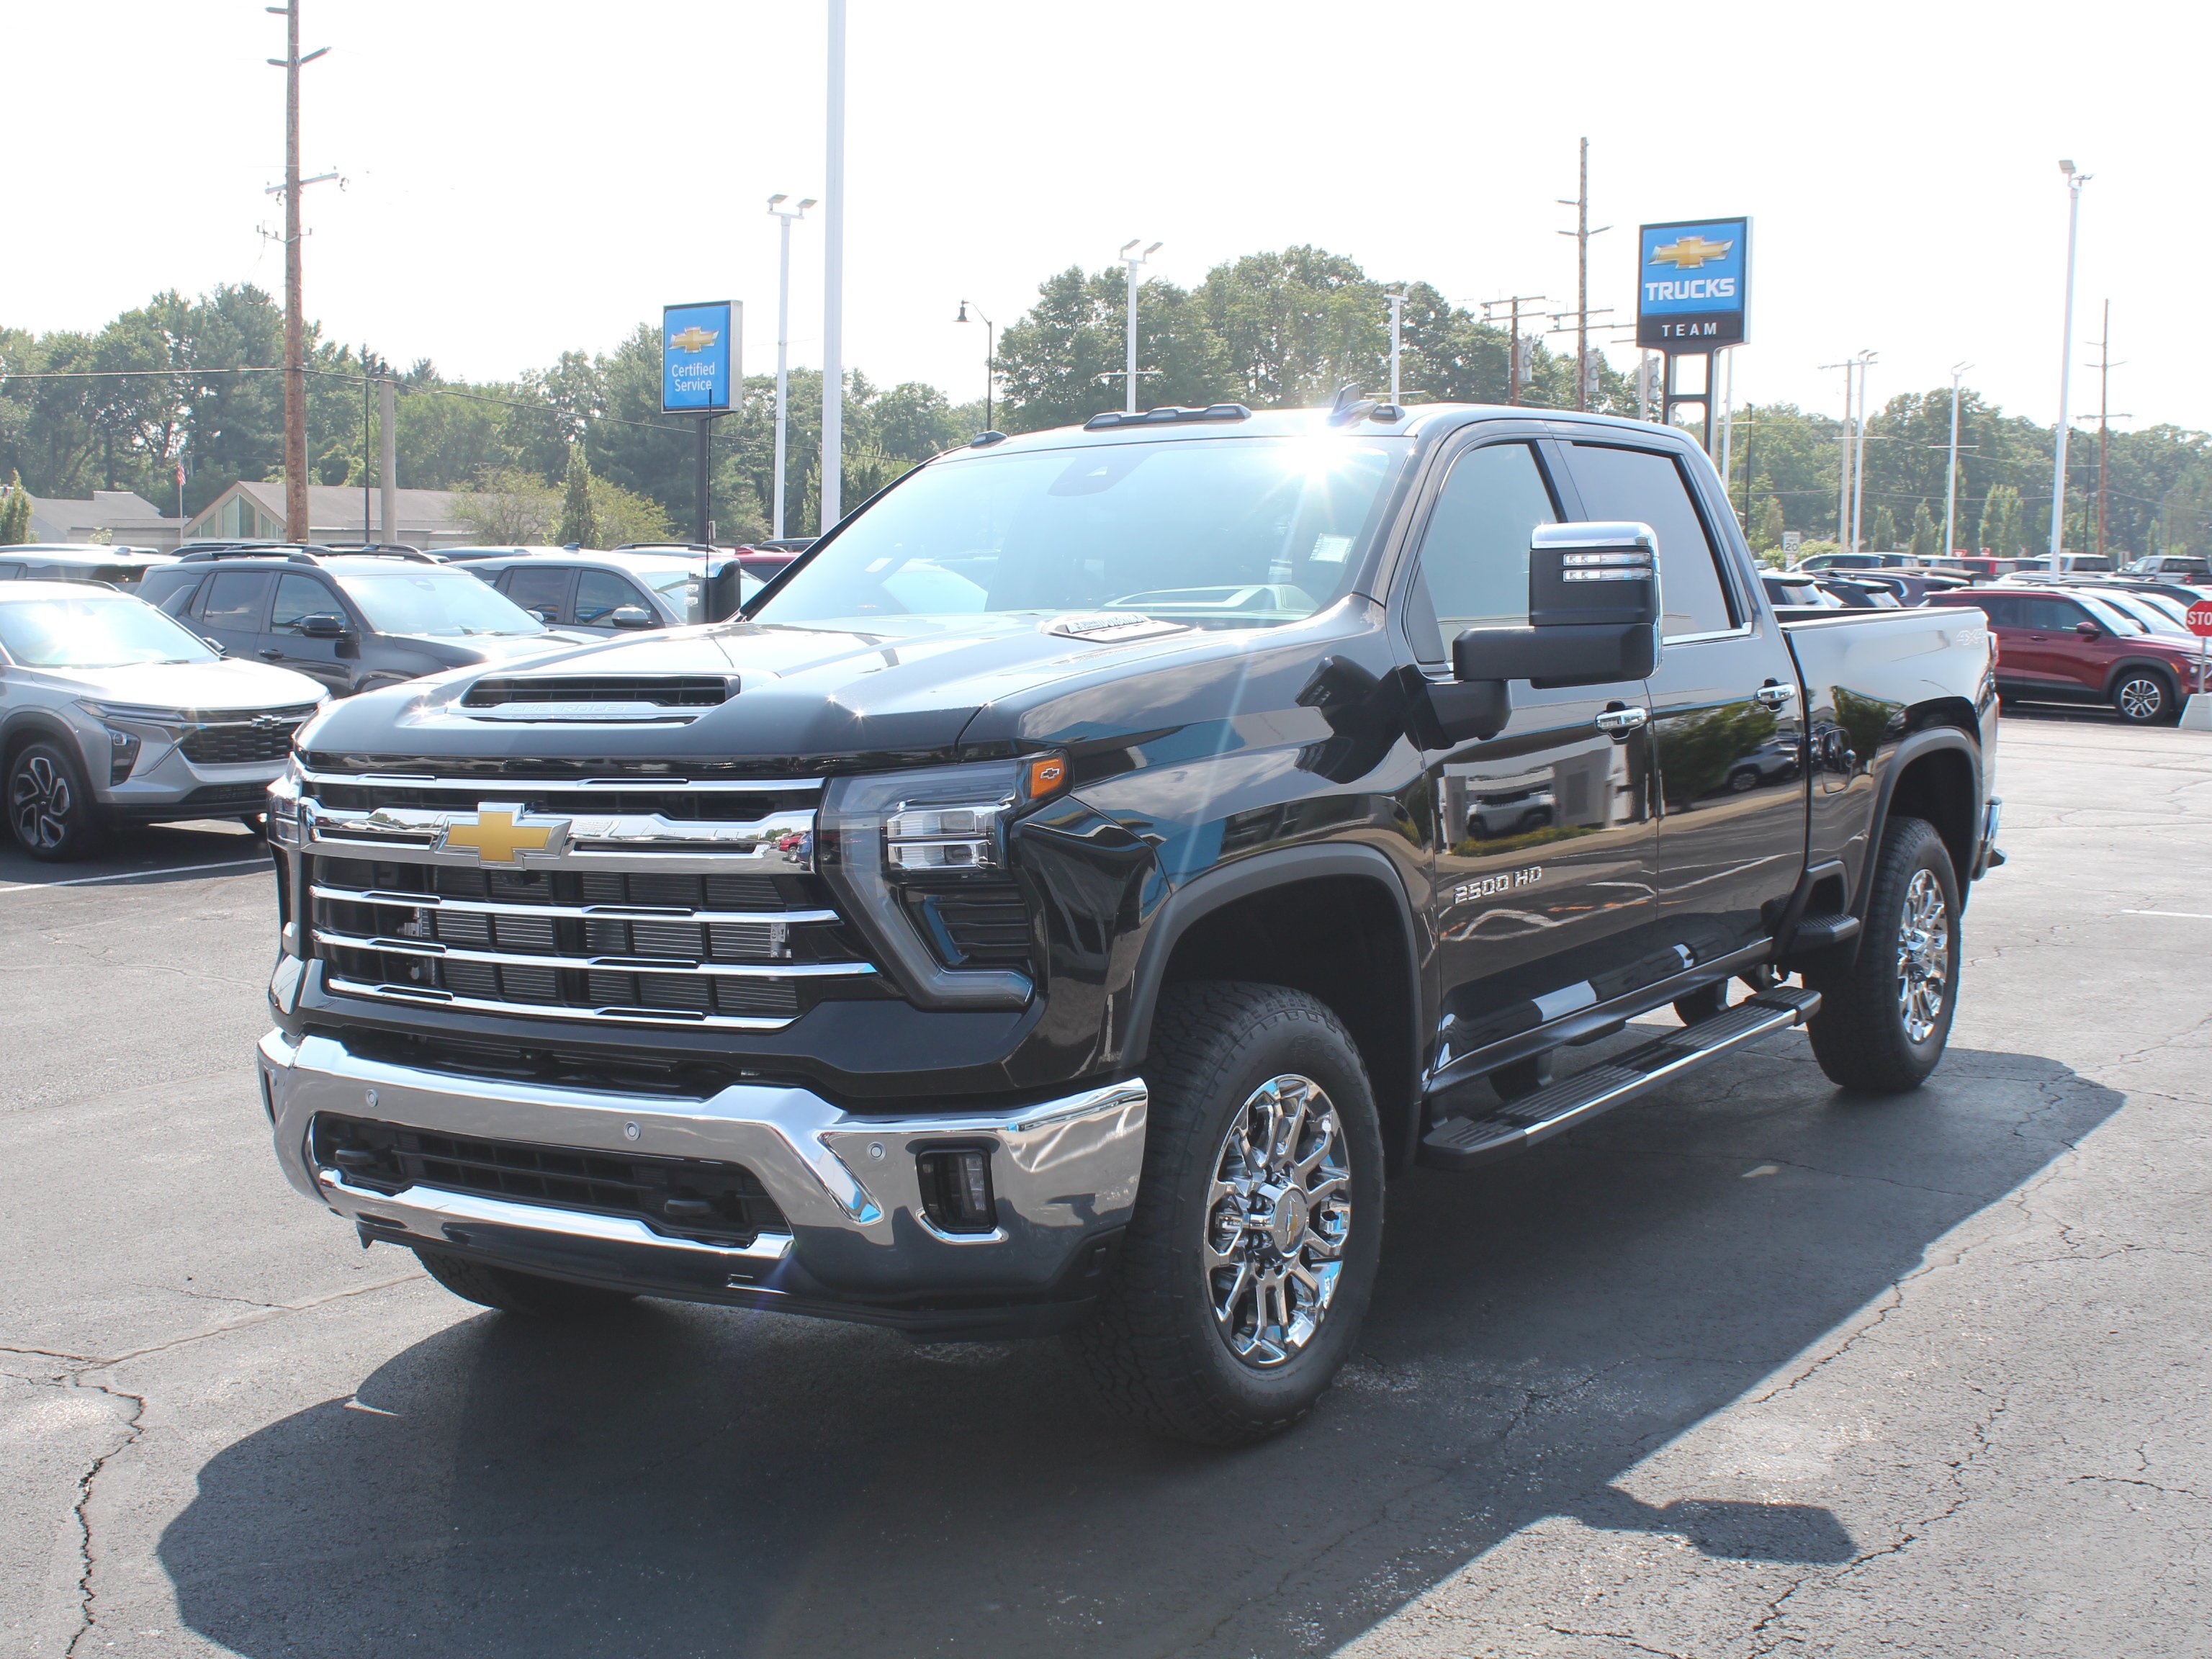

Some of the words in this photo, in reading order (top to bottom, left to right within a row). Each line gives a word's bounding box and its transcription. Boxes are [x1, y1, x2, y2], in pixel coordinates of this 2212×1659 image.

[1645, 277, 1735, 301] TRUCKS
[1661, 322, 1717, 337] TEAM
[672, 361, 715, 377] Certified
[675, 378, 712, 392] Service
[1785, 542, 1798, 552] 20
[2188, 611, 2212, 625] STO
[1454, 875, 1509, 904] 2500
[1514, 866, 1542, 887] HD
